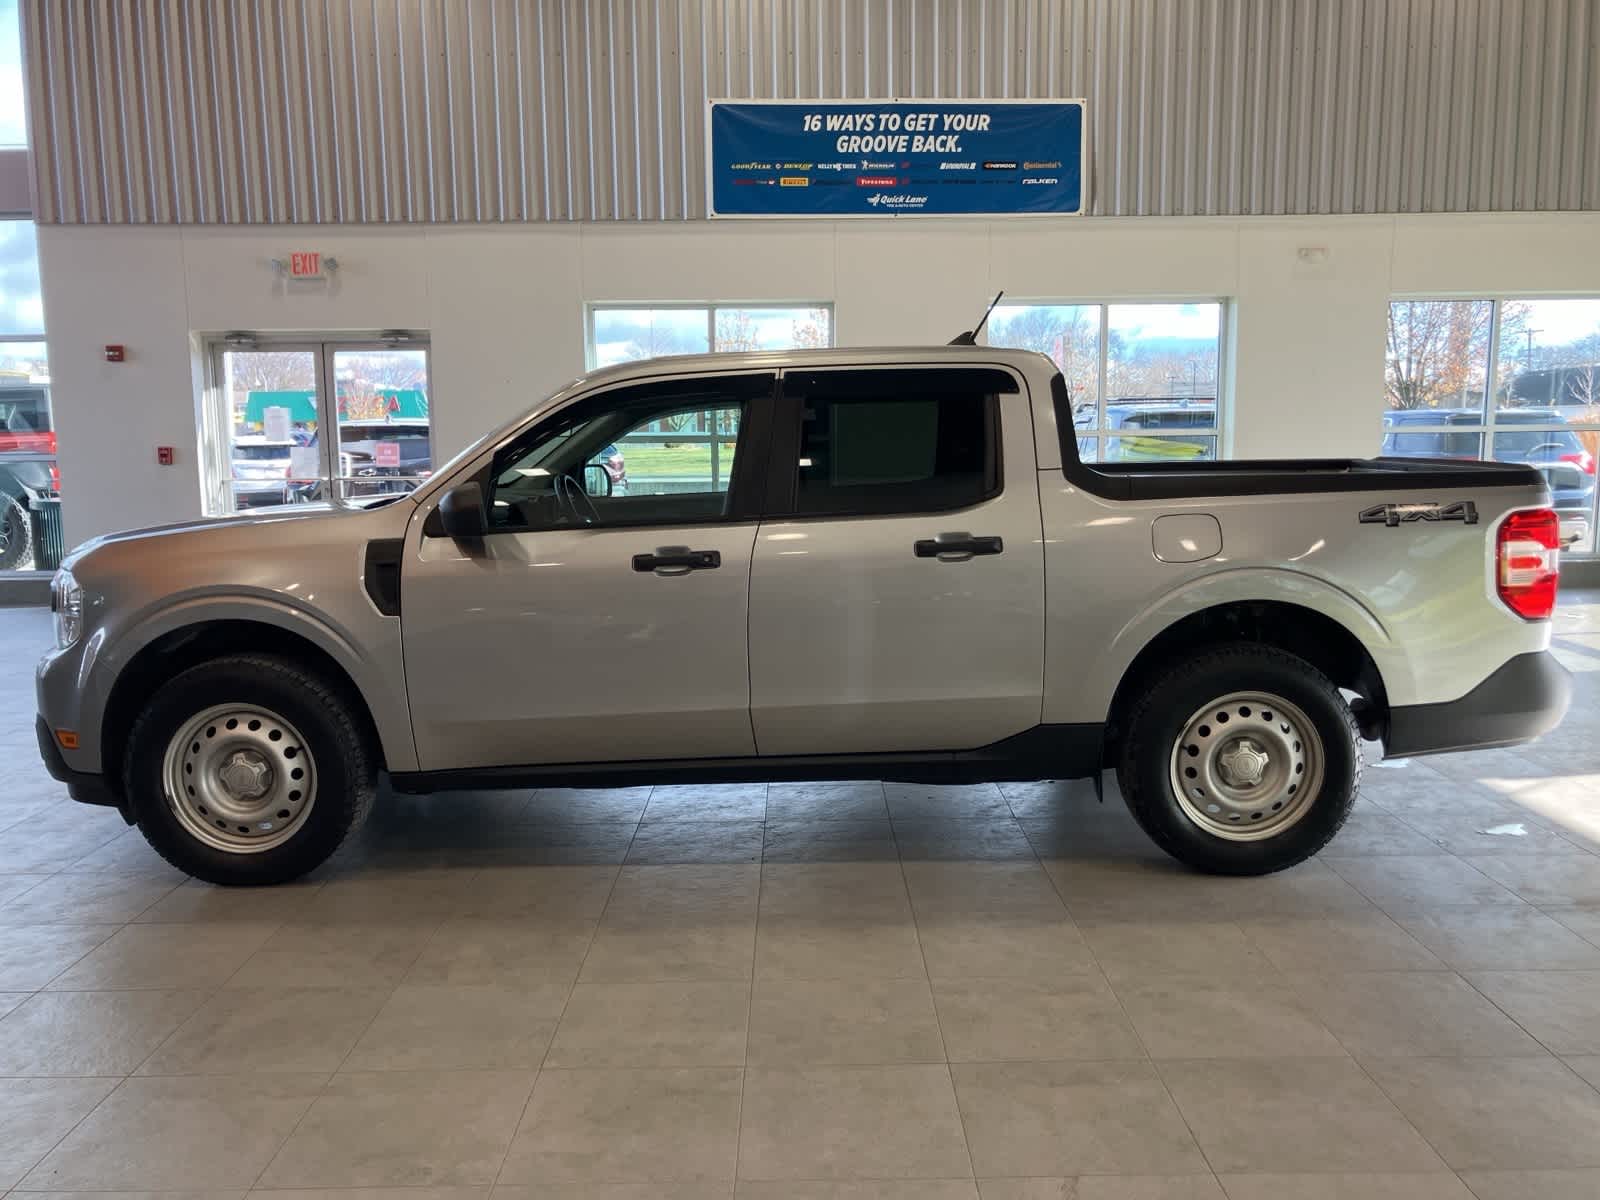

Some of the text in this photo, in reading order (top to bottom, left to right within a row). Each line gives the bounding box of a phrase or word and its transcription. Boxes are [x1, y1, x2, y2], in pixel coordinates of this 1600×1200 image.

[803, 113, 991, 132] 16 WAYS TO GET YOUR
[836, 135, 962, 153] GROOVE BACK.
[880, 195, 928, 204] Quick Lane
[291, 252, 320, 276] EXIT
